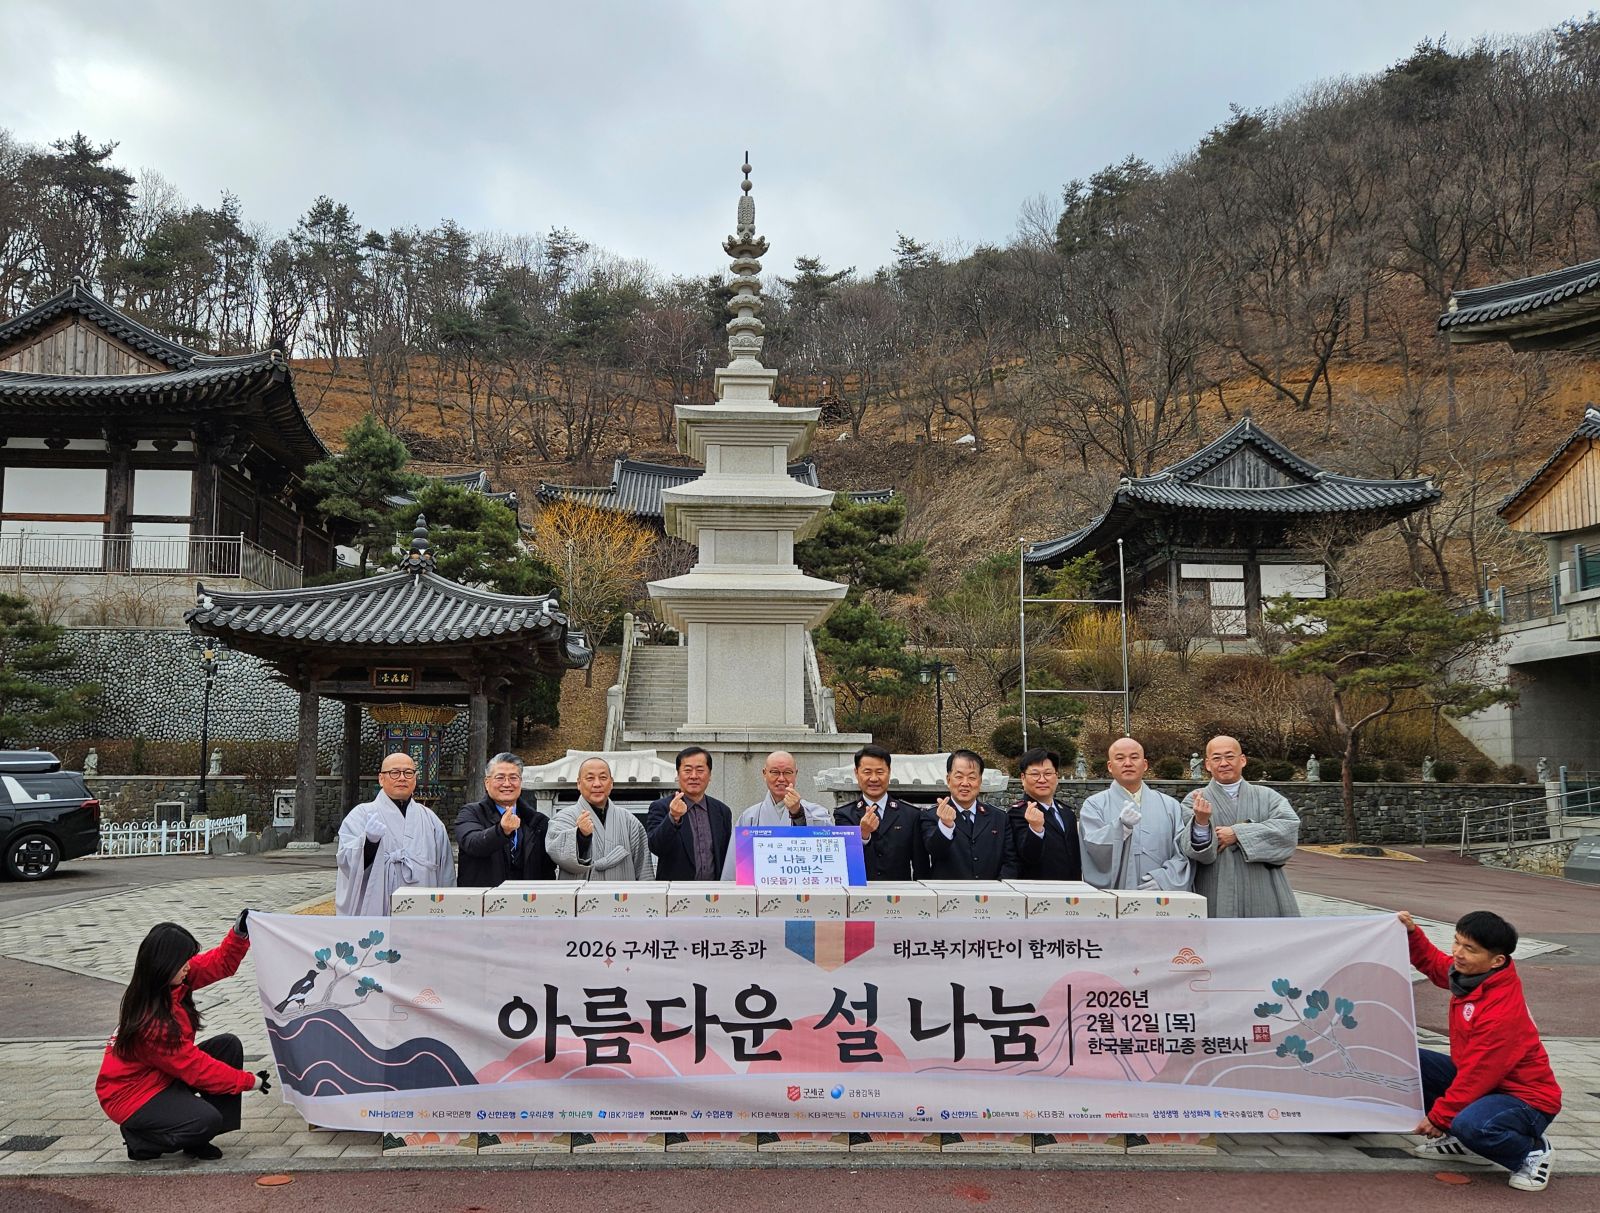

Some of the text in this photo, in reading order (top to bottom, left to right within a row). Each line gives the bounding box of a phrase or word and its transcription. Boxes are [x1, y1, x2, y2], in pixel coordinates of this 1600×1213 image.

[783, 854, 806, 864] 나눔
[812, 854, 835, 863] 키트
[780, 865, 824, 874] 100박스
[761, 876, 797, 886] 이웃돕기
[824, 876, 842, 885] 기탁
[566, 941, 616, 958] 2026
[893, 939, 1103, 960] 태고복지재단이 함께하는
[1086, 990, 1149, 1009] 2026년
[498, 983, 1050, 1066] 아름다운 설 나눔
[1086, 1013, 1196, 1033] 2월 12일 [목]
[1088, 1037, 1248, 1055] 한국불교태고종 청련사
[803, 1088, 825, 1096] 구세군
[848, 1089, 880, 1098] 금융감독원
[529, 1111, 554, 1119] 우리은행
[705, 1110, 733, 1119] 수협은행
[951, 1110, 979, 1119] 신한카드
[1105, 1110, 1129, 1119] meritz
[1152, 1110, 1179, 1119] 삼성생명
